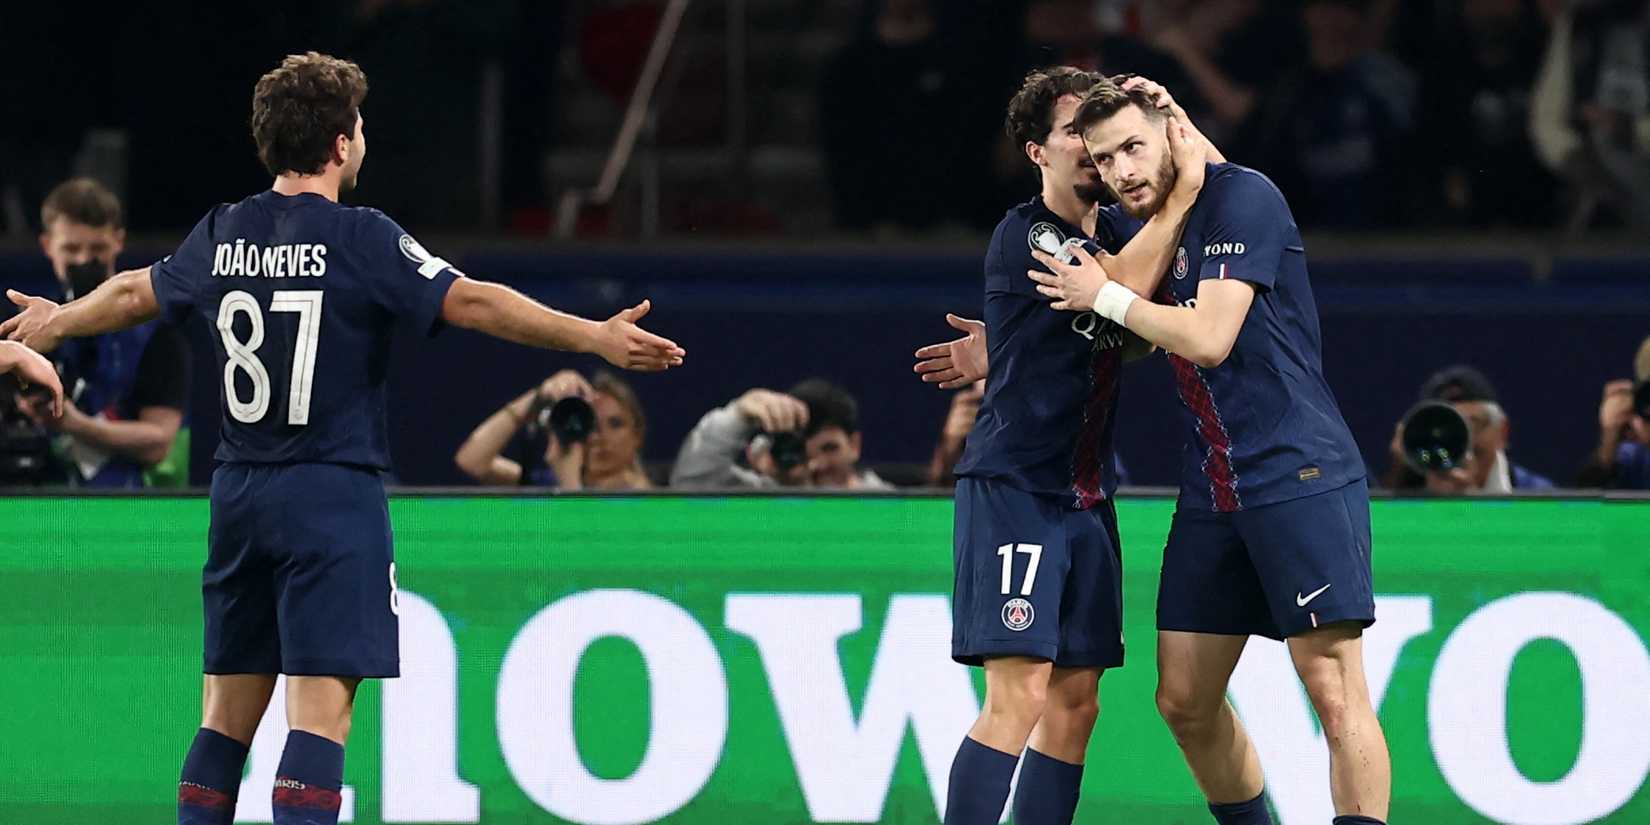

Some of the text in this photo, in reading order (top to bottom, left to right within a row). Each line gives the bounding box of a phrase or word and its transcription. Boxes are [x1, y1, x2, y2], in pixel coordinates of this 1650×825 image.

[212, 239, 327, 278] JOÃO NEVES
[215, 290, 324, 425] 87
[996, 543, 1044, 595] 17
